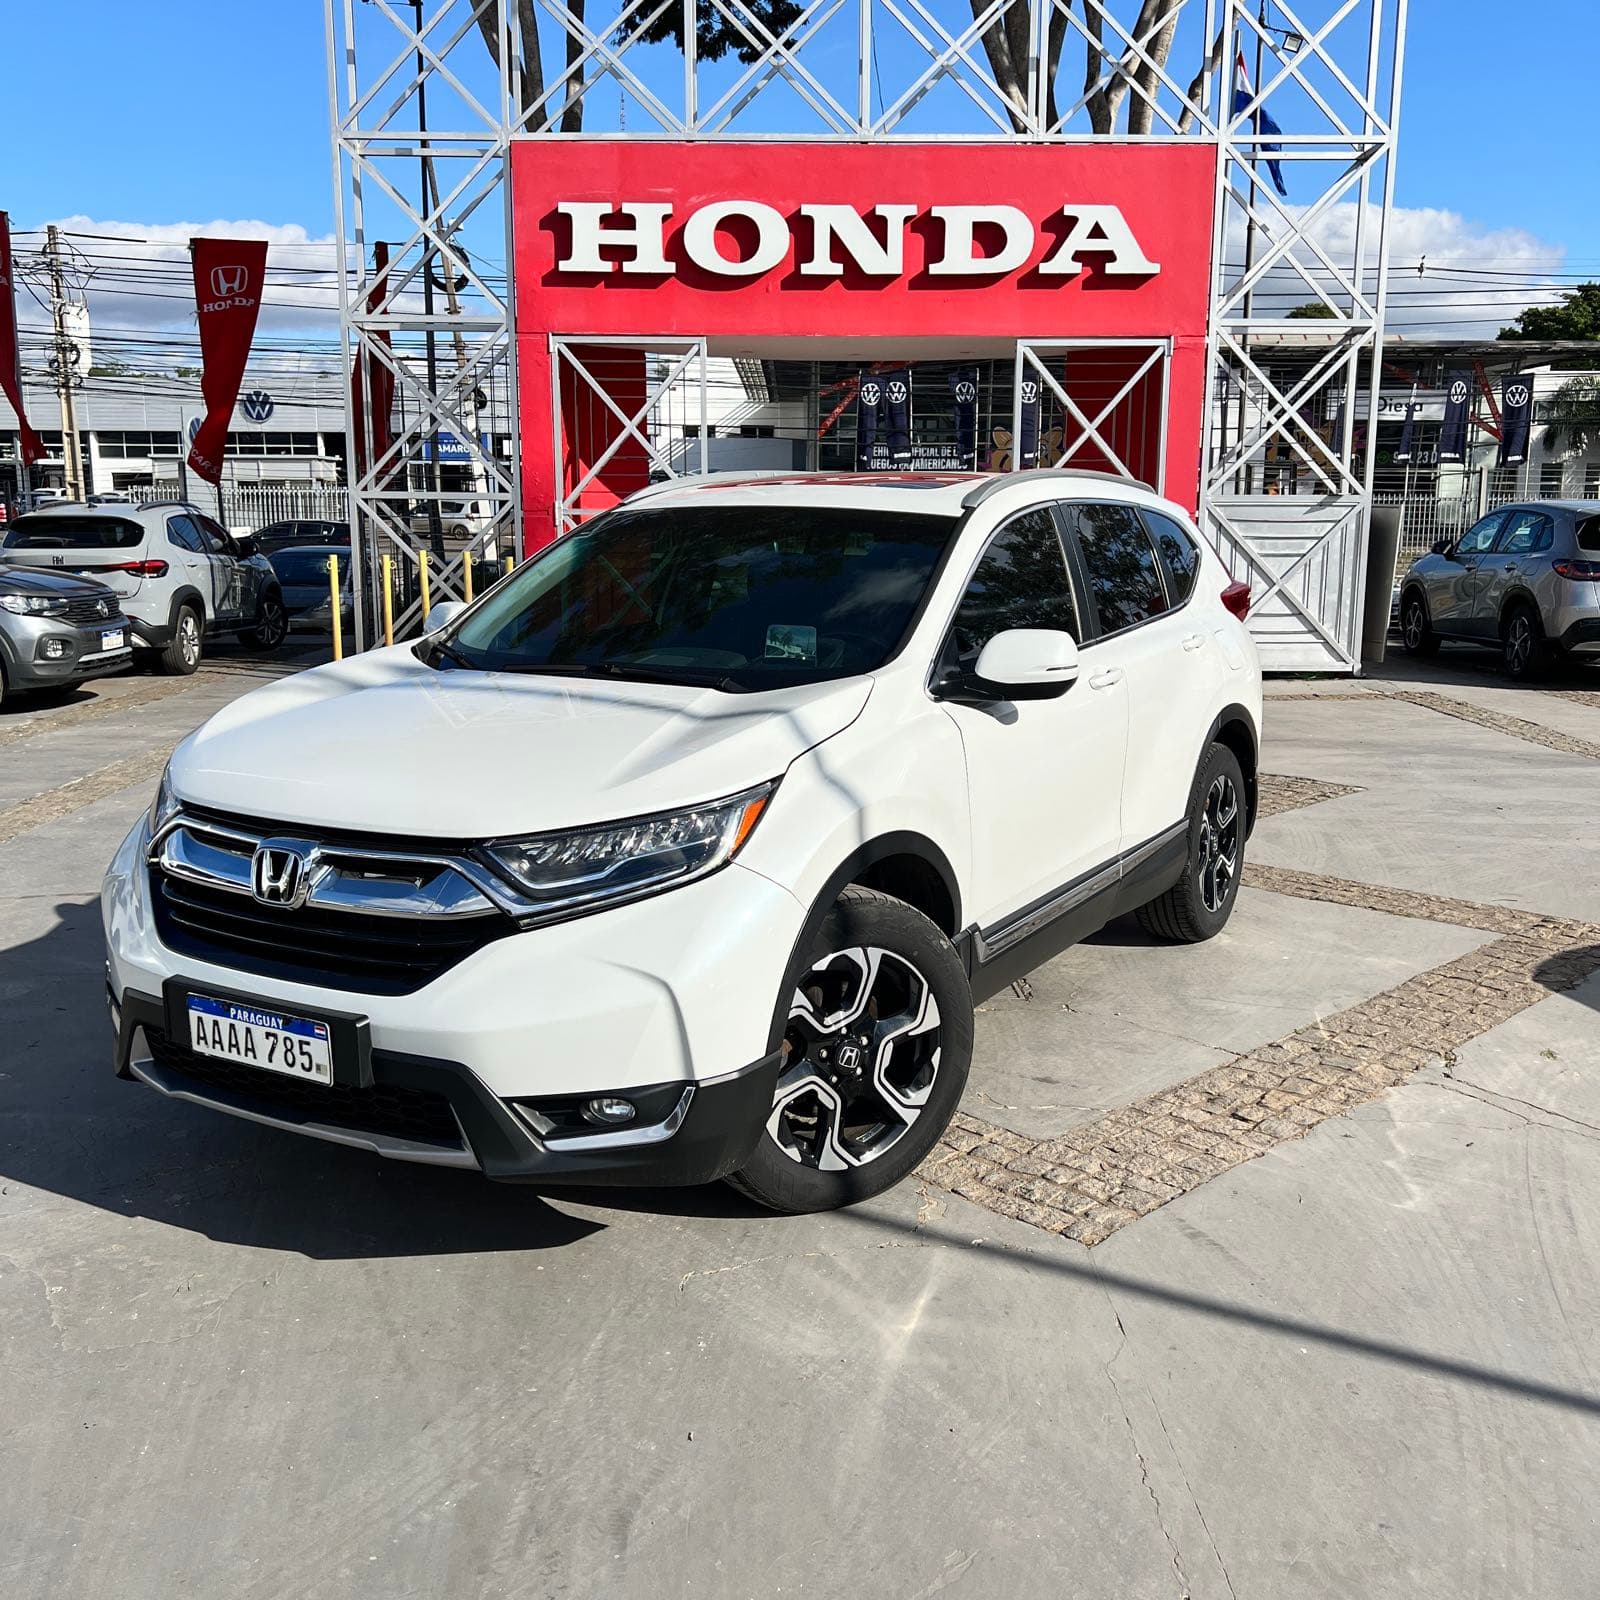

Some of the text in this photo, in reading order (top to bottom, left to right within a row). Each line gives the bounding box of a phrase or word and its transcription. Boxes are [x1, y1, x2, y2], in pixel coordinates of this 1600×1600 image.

[557, 200, 1162, 276] HONDA
[196, 1015, 313, 1072] AAAA 785
[230, 1007, 283, 1029] PARAGUAY
